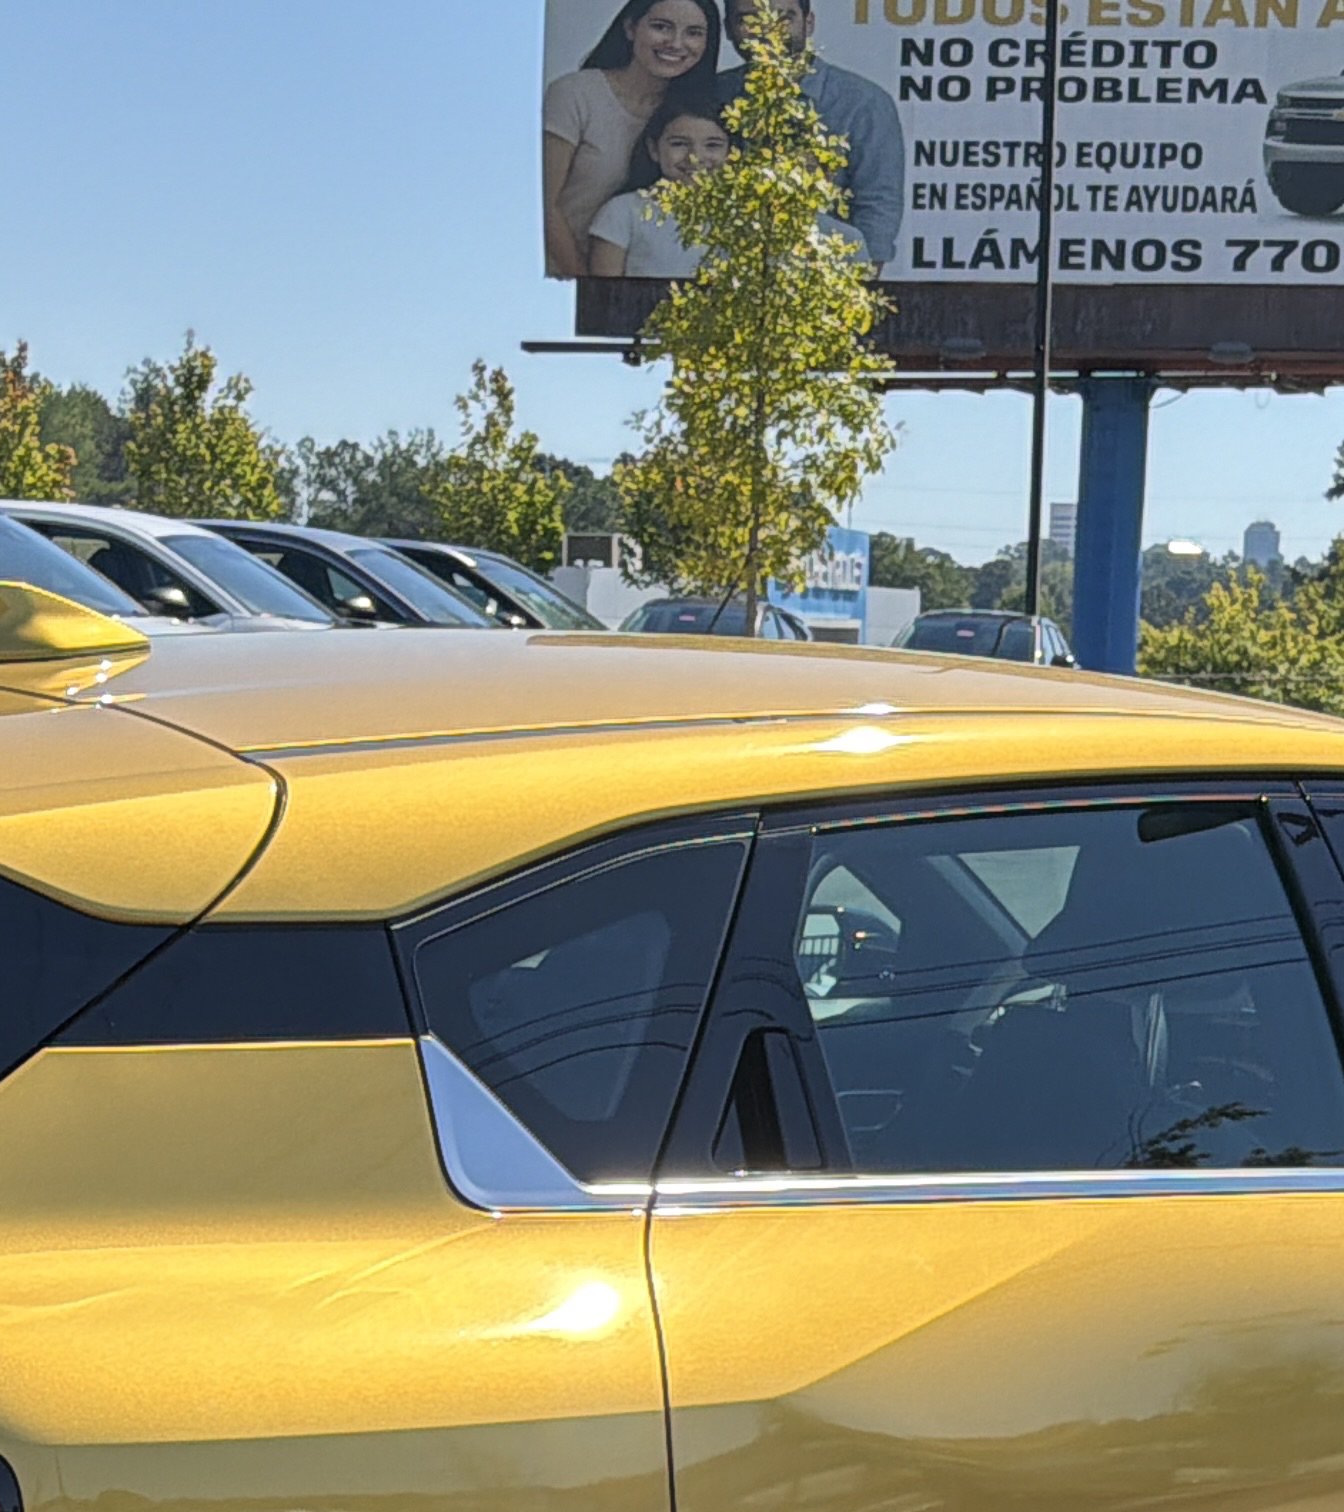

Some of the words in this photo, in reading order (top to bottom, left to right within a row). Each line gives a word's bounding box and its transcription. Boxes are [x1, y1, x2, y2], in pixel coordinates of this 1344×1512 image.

[900, 37, 974, 68] NO
[988, 31, 1218, 69] CRÉDITO
[899, 75, 971, 102] NO
[986, 75, 1268, 104] PROBLEMA
[913, 140, 1067, 168] NUESTRO
[1075, 141, 1203, 173] EQUIPO
[912, 182, 948, 210] EN
[955, 177, 1080, 212] ESPAÑOL
[1086, 184, 1119, 212] TE
[1124, 178, 1258, 214] AYUDARÁ
[911, 228, 1203, 273] LLÁMENOS
